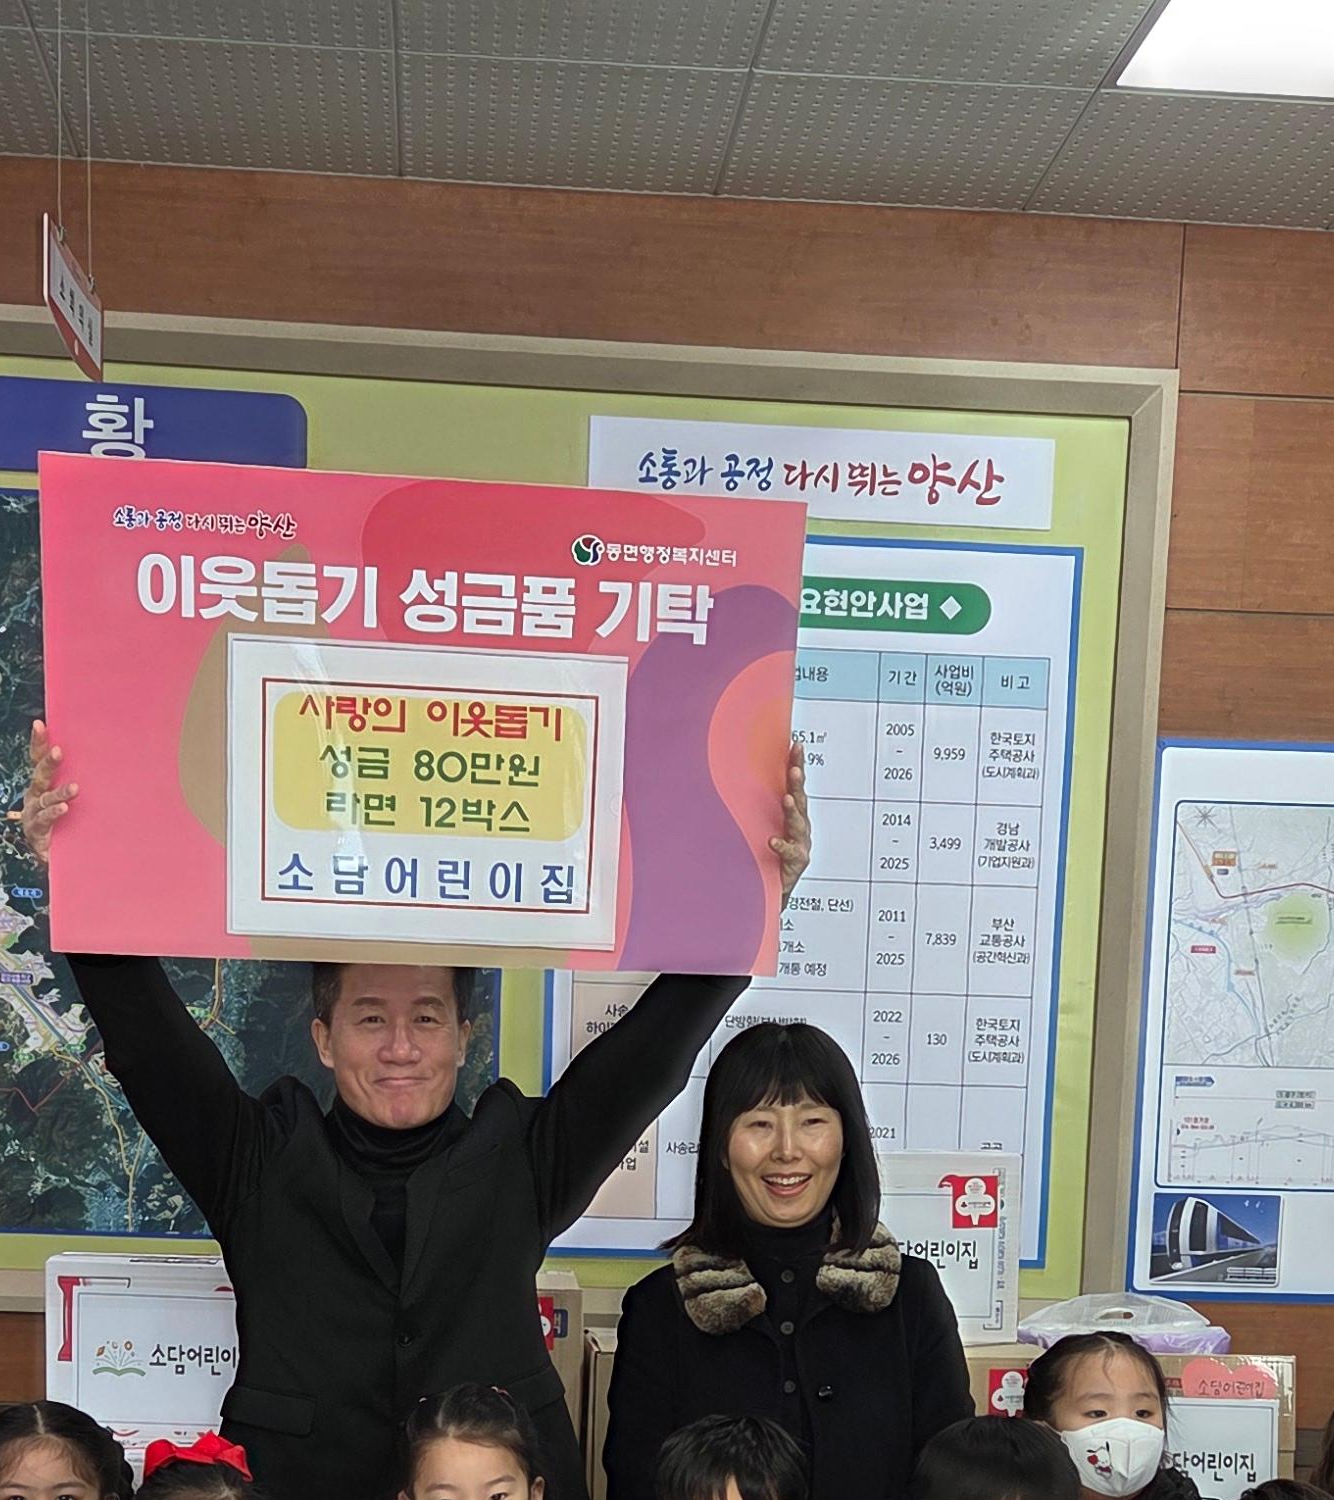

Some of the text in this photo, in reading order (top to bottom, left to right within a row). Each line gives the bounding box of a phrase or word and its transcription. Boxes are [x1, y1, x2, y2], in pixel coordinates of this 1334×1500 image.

[82, 393, 154, 460] 황
[637, 447, 1006, 506] 소통과 공정 다시 뛰는 양산
[114, 505, 298, 538] 소통과 공정 다시 뛰는 양산
[605, 543, 738, 569] 동면행정복지센터
[137, 553, 715, 646] 이웃돕기 성금품 기탁
[934, 665, 975, 681] 사업비
[934, 680, 973, 698] (억원)
[298, 693, 563, 743] 사랑의 이웃돕기
[885, 723, 915, 737] 2005
[989, 731, 1036, 747] 한국토지
[319, 745, 542, 788] 성금 80만원
[988, 748, 1035, 764] 주택공사
[883, 767, 913, 781] 2026
[325, 788, 531, 835] 라면 12박스
[881, 813, 1020, 851] 2014 3,499 경남
[879, 838, 1031, 870] 2025 개발공사
[827, 897, 1015, 946] 단선) 2011 7,839 부산
[978, 934, 1026, 949] 교통공사
[803, 962, 828, 977] 예정
[875, 952, 905, 966] 2025
[872, 1010, 903, 1024] 2022
[975, 1018, 1021, 1032] 한국토지
[926, 1033, 1020, 1048] 130 주택공사
[871, 1052, 901, 1066] 2026
